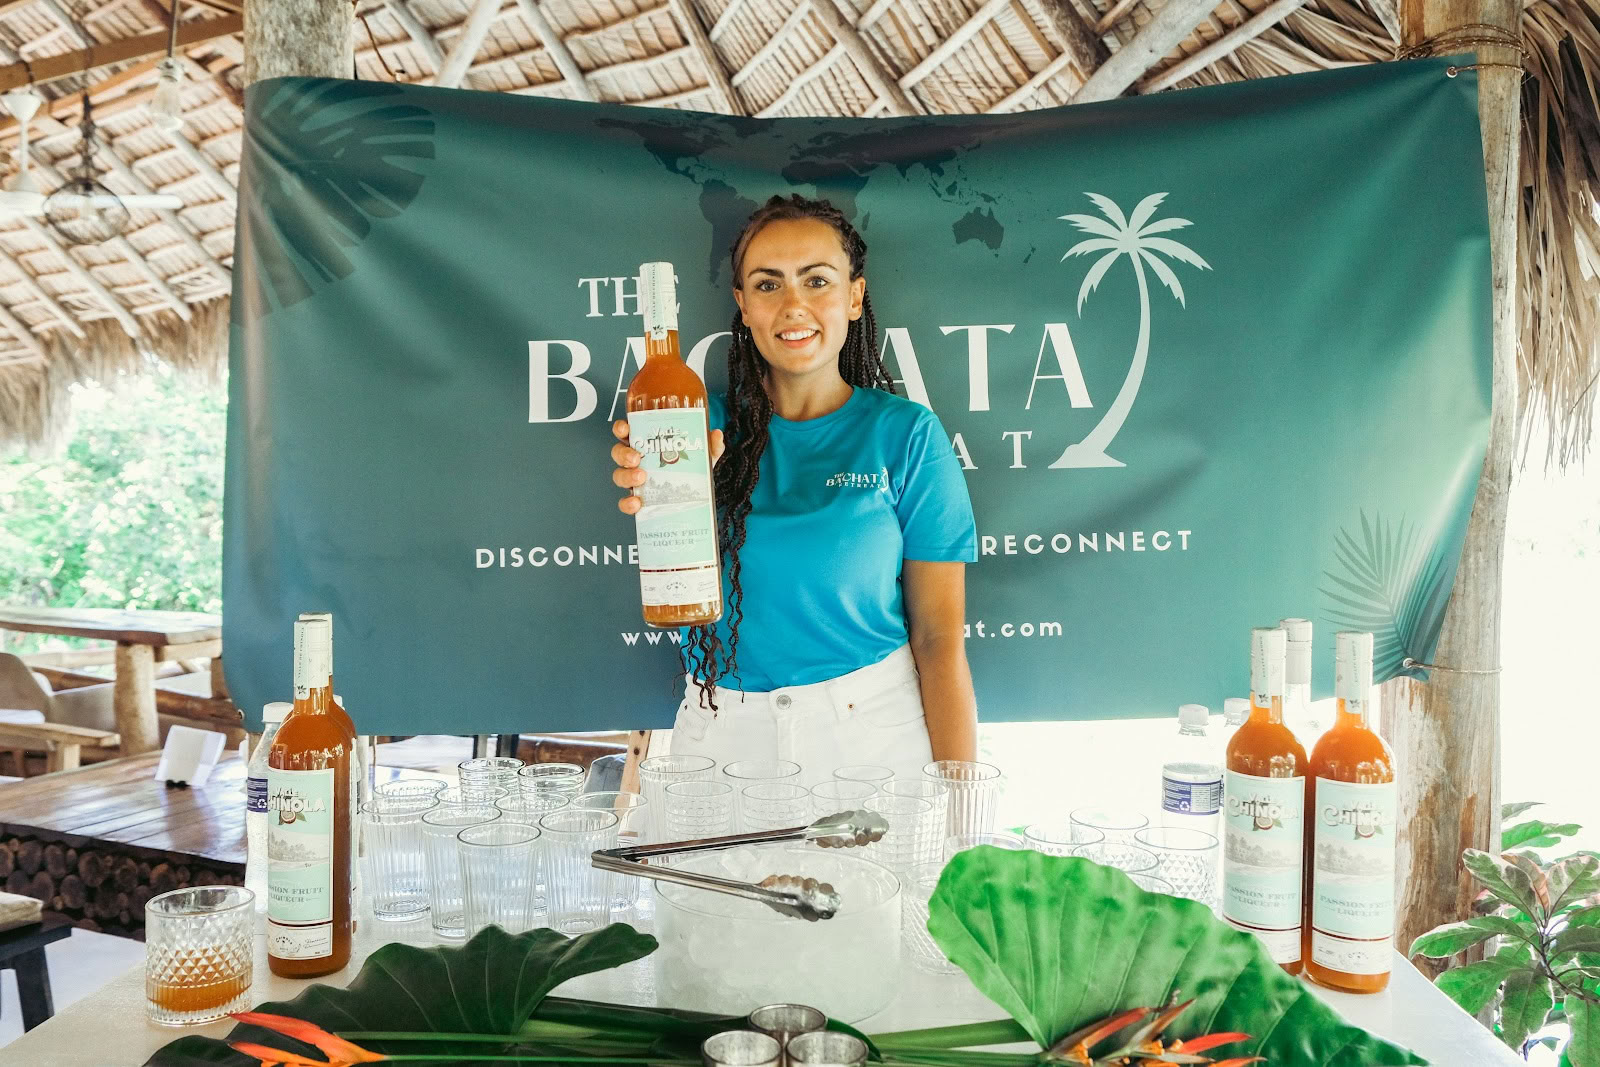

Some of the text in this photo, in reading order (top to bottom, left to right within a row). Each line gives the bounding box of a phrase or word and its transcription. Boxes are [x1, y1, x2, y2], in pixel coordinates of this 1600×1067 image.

[578, 276, 681, 317] TH
[528, 323, 1093, 423] BAATA
[640, 528, 709, 540] PASSION FRUIT
[653, 538, 695, 547] LIQUEUR
[475, 530, 1192, 569] DISCONNE RECONNECT
[268, 797, 327, 813] HINOLA
